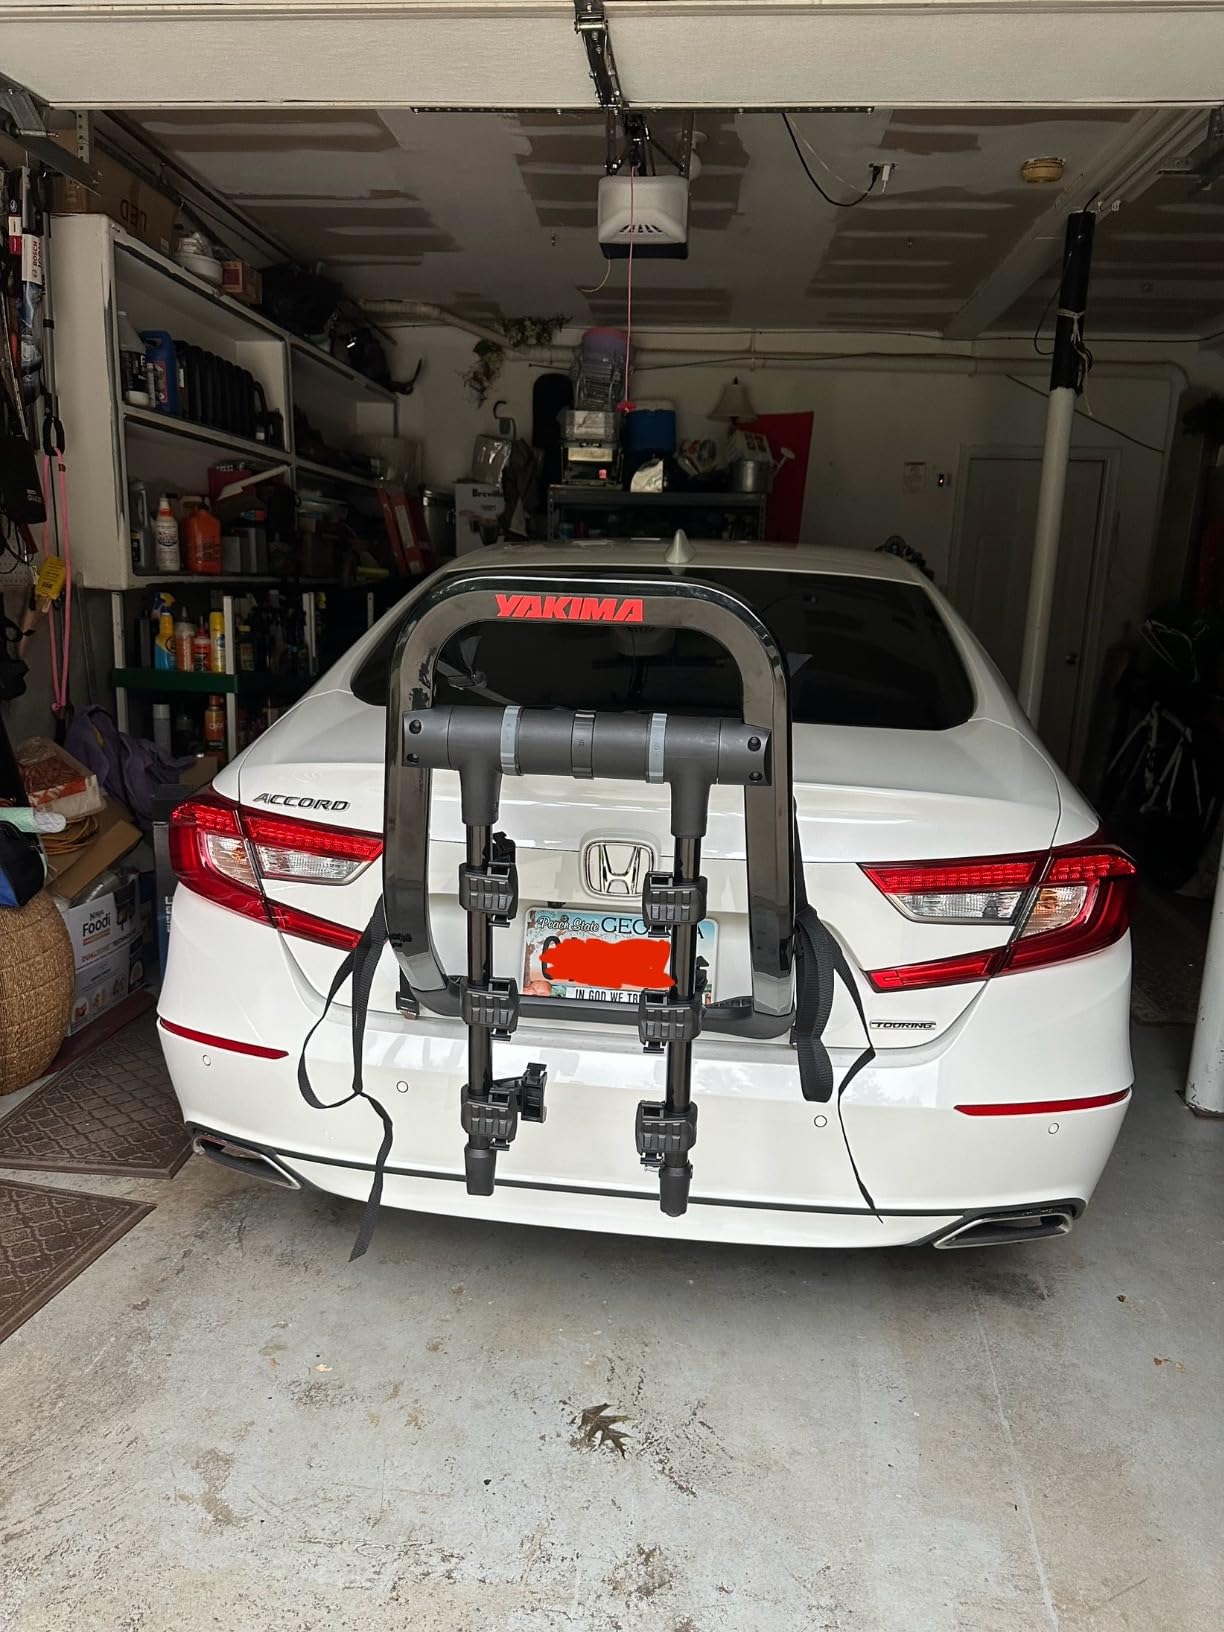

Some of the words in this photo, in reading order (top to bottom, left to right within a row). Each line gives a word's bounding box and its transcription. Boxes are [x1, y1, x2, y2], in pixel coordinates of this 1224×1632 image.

[495, 594, 643, 622] YAKIMA
[252, 792, 349, 811] ACCORD
[82, 911, 111, 938] Foodi
[536, 915, 569, 930] Peach
[571, 916, 600, 932] State
[575, 988, 586, 1001] IN
[588, 989, 607, 1002] GOD
[871, 1021, 937, 1029] TOURING
